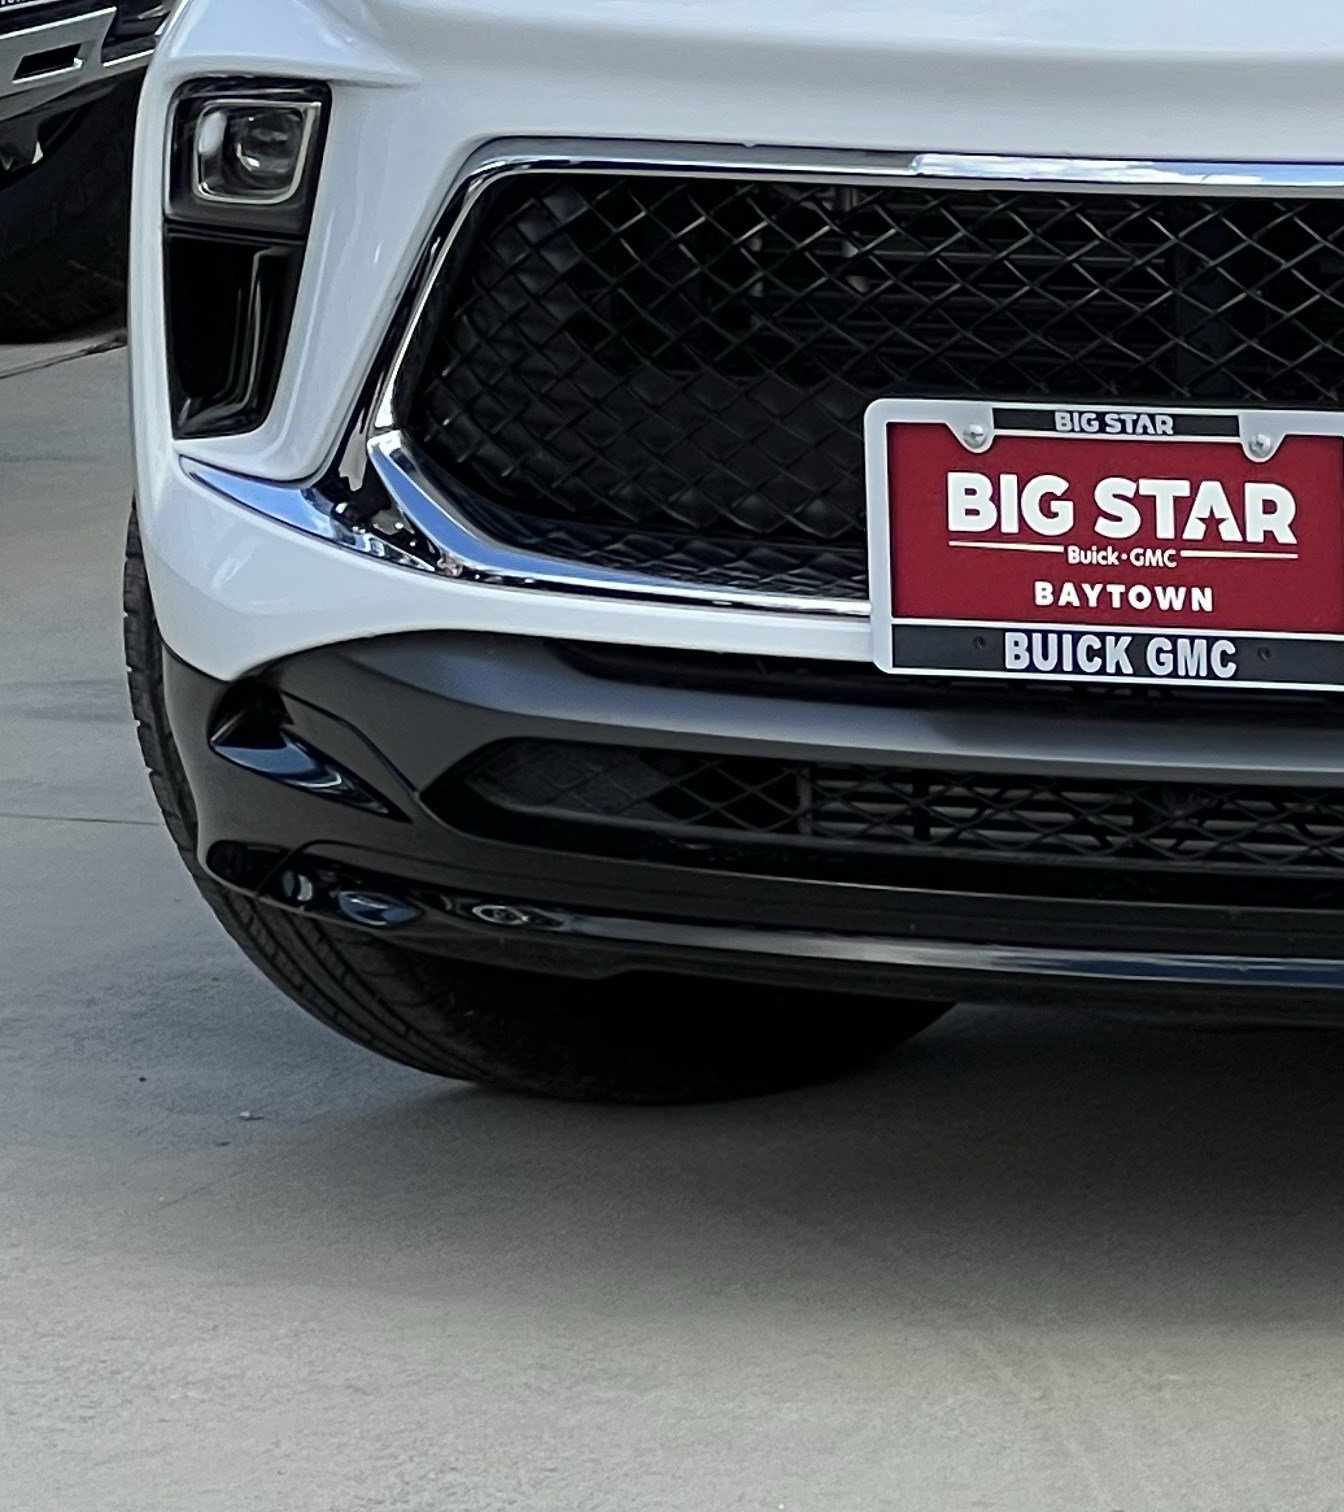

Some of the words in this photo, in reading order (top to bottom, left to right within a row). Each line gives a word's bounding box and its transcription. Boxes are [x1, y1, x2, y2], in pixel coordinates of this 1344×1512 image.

[1054, 412, 1099, 433] BIG
[1105, 413, 1174, 436] STAR
[946, 471, 1074, 536] BIG
[1093, 476, 1298, 545] STAR
[1067, 544, 1120, 567] Buick
[1130, 547, 1177, 569] GMC
[1034, 580, 1214, 612] BAYTOWN
[1004, 631, 1134, 676] BUICK
[1146, 637, 1238, 679] GMC
